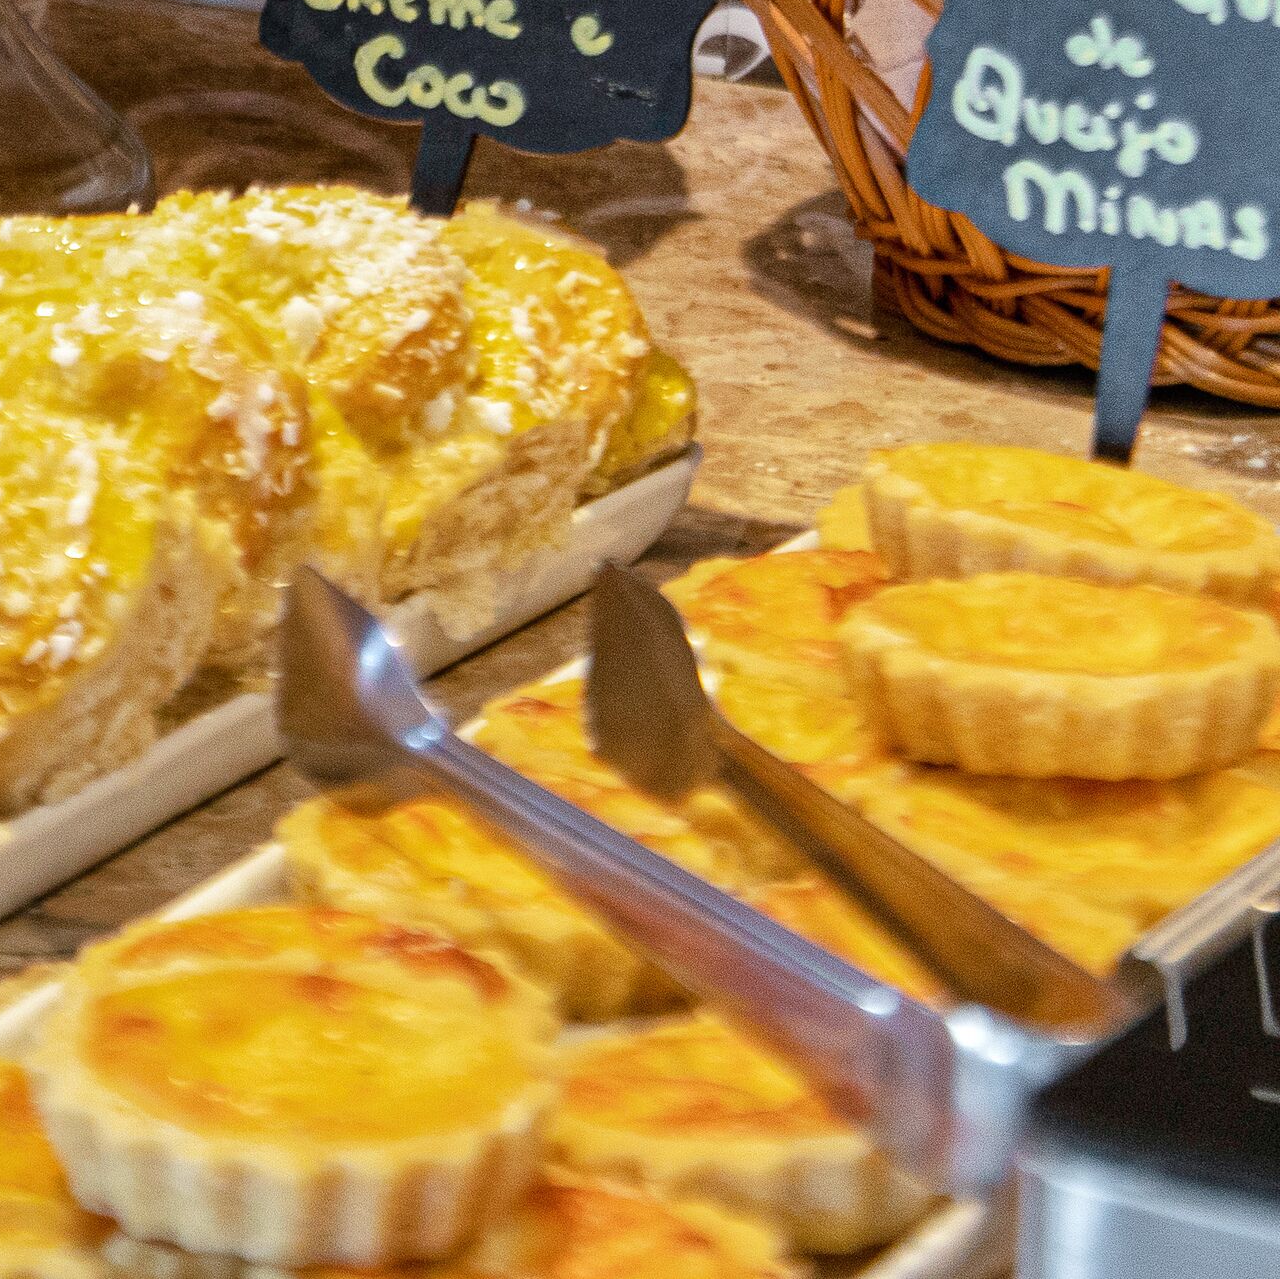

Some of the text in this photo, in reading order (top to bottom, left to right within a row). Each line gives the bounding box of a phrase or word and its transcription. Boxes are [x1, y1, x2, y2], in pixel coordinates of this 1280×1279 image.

[353, 33, 527, 128] Coco
[570, 14, 615, 57] e
[1063, 14, 1155, 78] de
[951, 45, 1201, 177] Queijo
[1003, 159, 1270, 262] Minas
